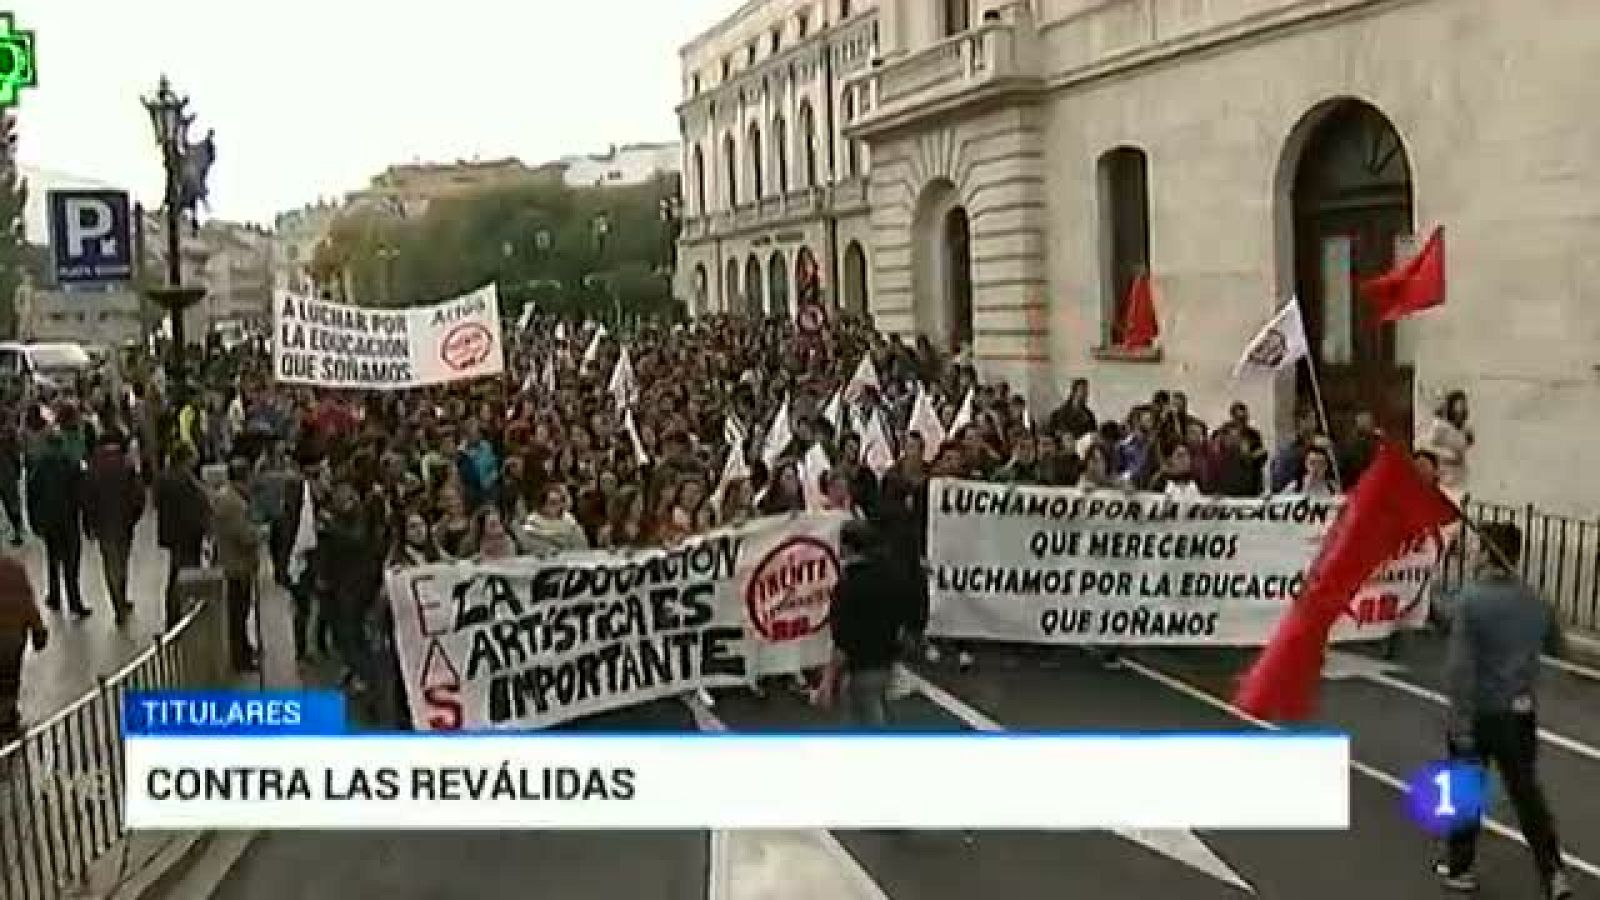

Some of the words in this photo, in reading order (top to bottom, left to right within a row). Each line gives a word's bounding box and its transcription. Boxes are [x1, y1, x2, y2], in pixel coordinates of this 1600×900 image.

[65, 199, 113, 256] P
[282, 297, 296, 318] A
[298, 300, 369, 333] LUCHAR
[371, 313, 407, 336] POR
[281, 323, 306, 350] LA
[281, 353, 317, 379] QUE
[941, 488, 1082, 519] LUCHAMOS
[1087, 498, 1143, 521] POR
[1030, 530, 1080, 559] QUE
[1089, 531, 1239, 560] MERECEMOS
[936, 564, 1075, 594] LUCHAMOS
[1079, 569, 1131, 597] POR
[1139, 572, 1171, 597] LA
[1179, 569, 1307, 600] EDUCACIÓ
[452, 571, 523, 633] LA
[650, 584, 716, 632] ES
[1040, 608, 1091, 636] QUE
[1096, 604, 1220, 637] SOÑAMOS
[489, 627, 747, 722] IMPORTANTE
